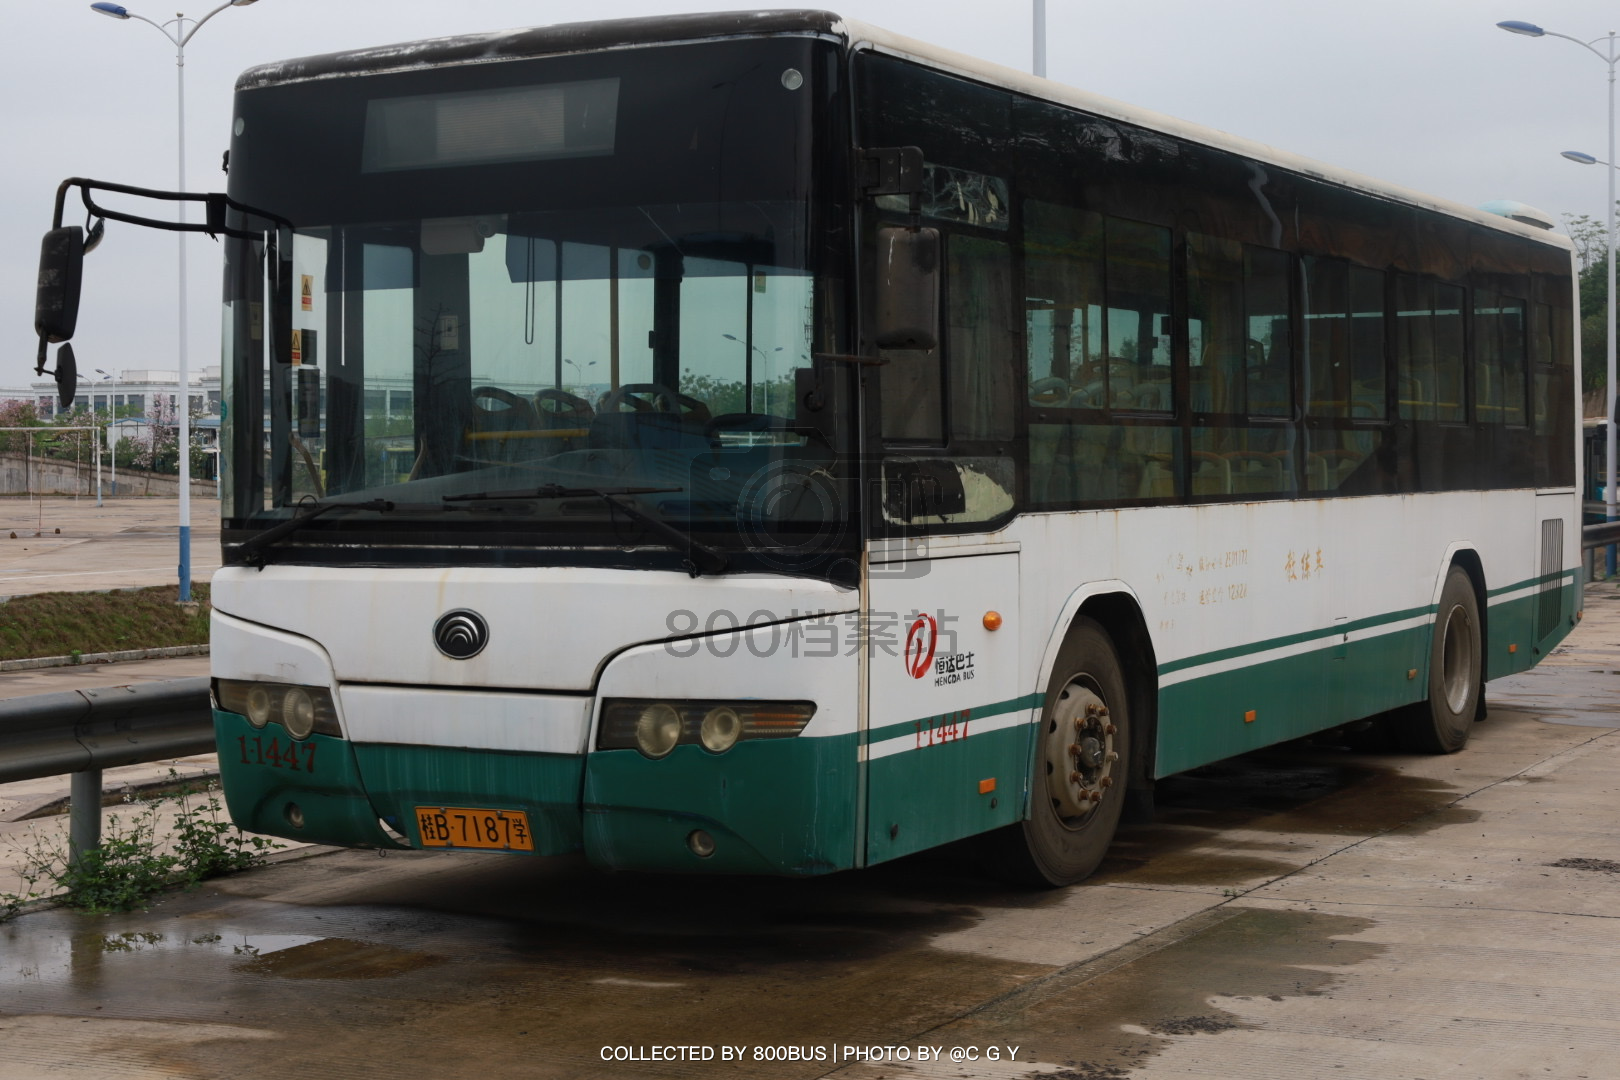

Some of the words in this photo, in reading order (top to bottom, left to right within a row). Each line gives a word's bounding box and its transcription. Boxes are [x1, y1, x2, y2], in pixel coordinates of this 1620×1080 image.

[935, 651, 975, 675] 恒达巴士
[934, 673, 961, 687] HENGDA
[963, 669, 975, 680] BUS
